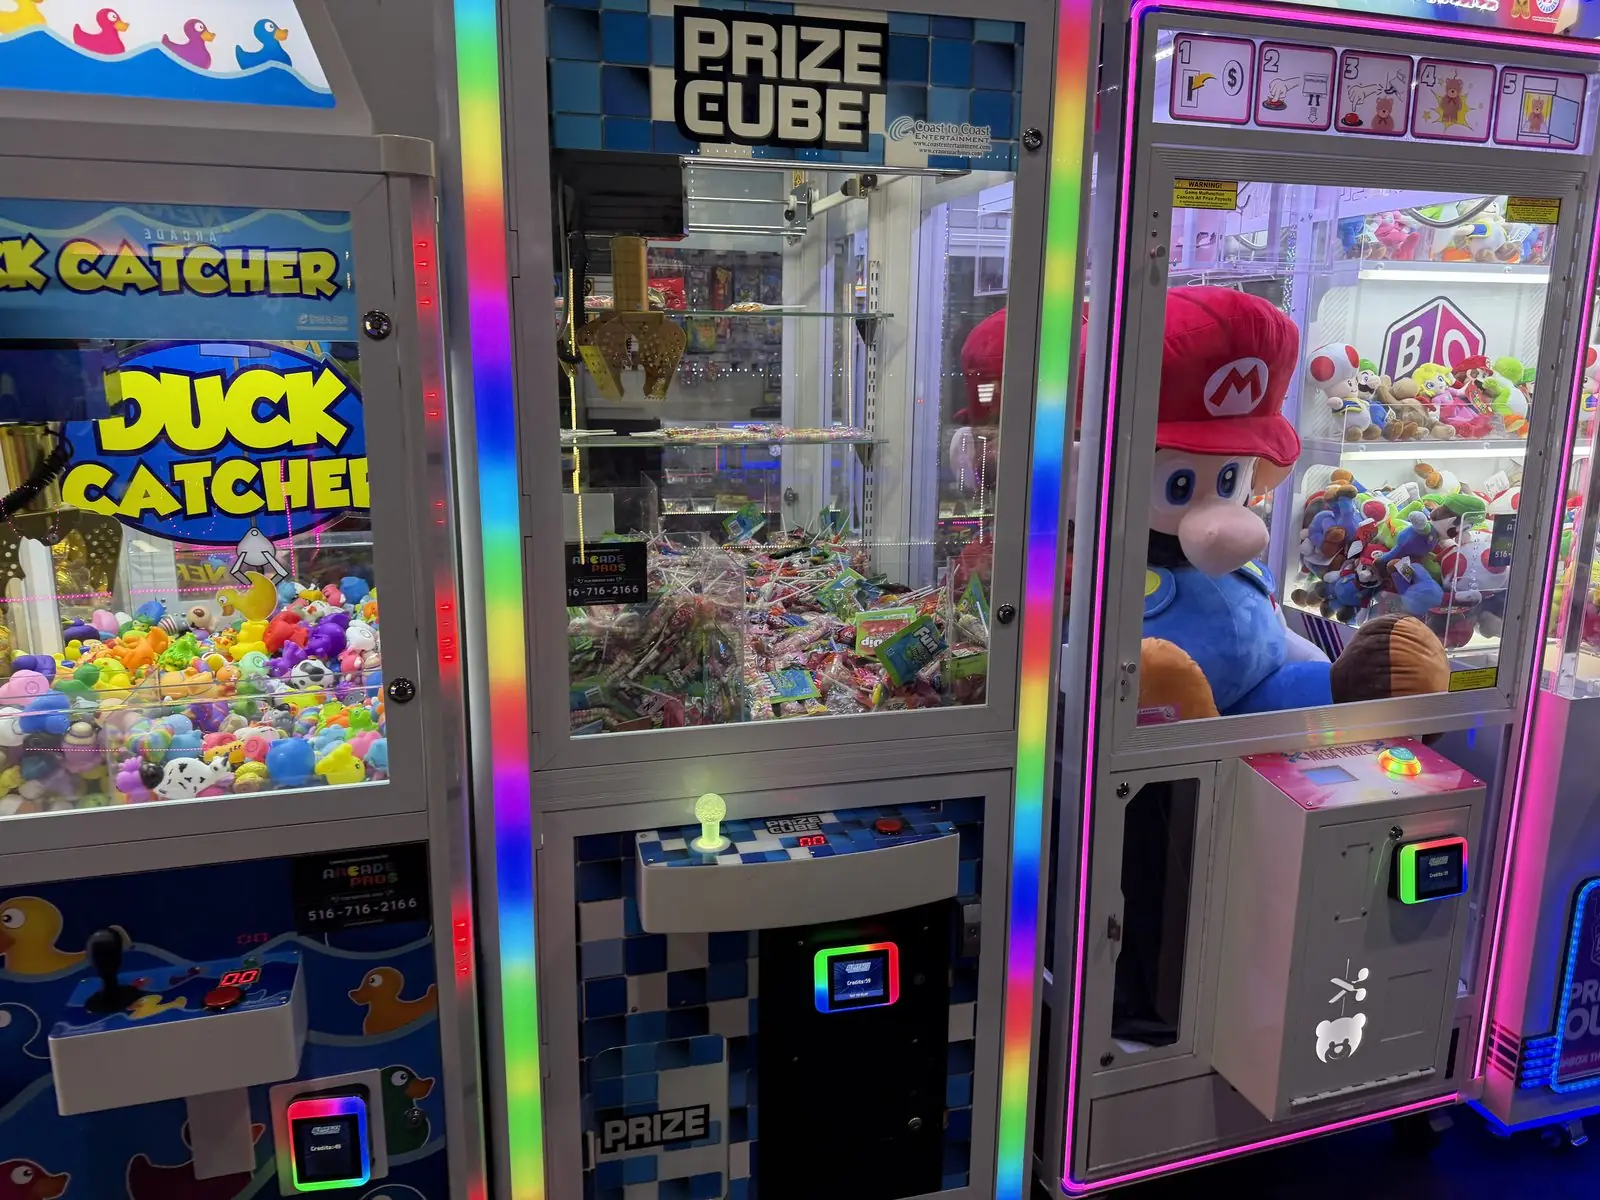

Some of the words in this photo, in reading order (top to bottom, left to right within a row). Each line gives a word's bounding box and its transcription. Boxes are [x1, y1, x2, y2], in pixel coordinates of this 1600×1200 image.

[683, 16, 883, 86] PRIZE
[1179, 40, 1192, 64] 1
[1263, 48, 1280, 73] 2
[1343, 56, 1360, 80] 3
[1420, 64, 1437, 88] 4
[1502, 73, 1518, 95] 5
[683, 79, 866, 143] CUBE
[915, 120, 945, 134] Coast
[948, 122, 958, 134] to
[961, 123, 991, 136] Coast
[915, 133, 990, 143] ENTERTAINMENT
[1188, 181, 1223, 189] WARNING!
[58, 239, 341, 299] CATCHER
[98, 366, 348, 452] DUCK
[913, 626, 939, 654] Fun
[1306, 746, 1341, 761] MEGA
[1339, 743, 1373, 759] PRIZE
[766, 815, 820, 828] PRIZE
[768, 823, 820, 834] CUBE
[308, 897, 417, 921] 516-716-2166
[221, 969, 258, 986] 00
[604, 1107, 705, 1149] PRIZE
